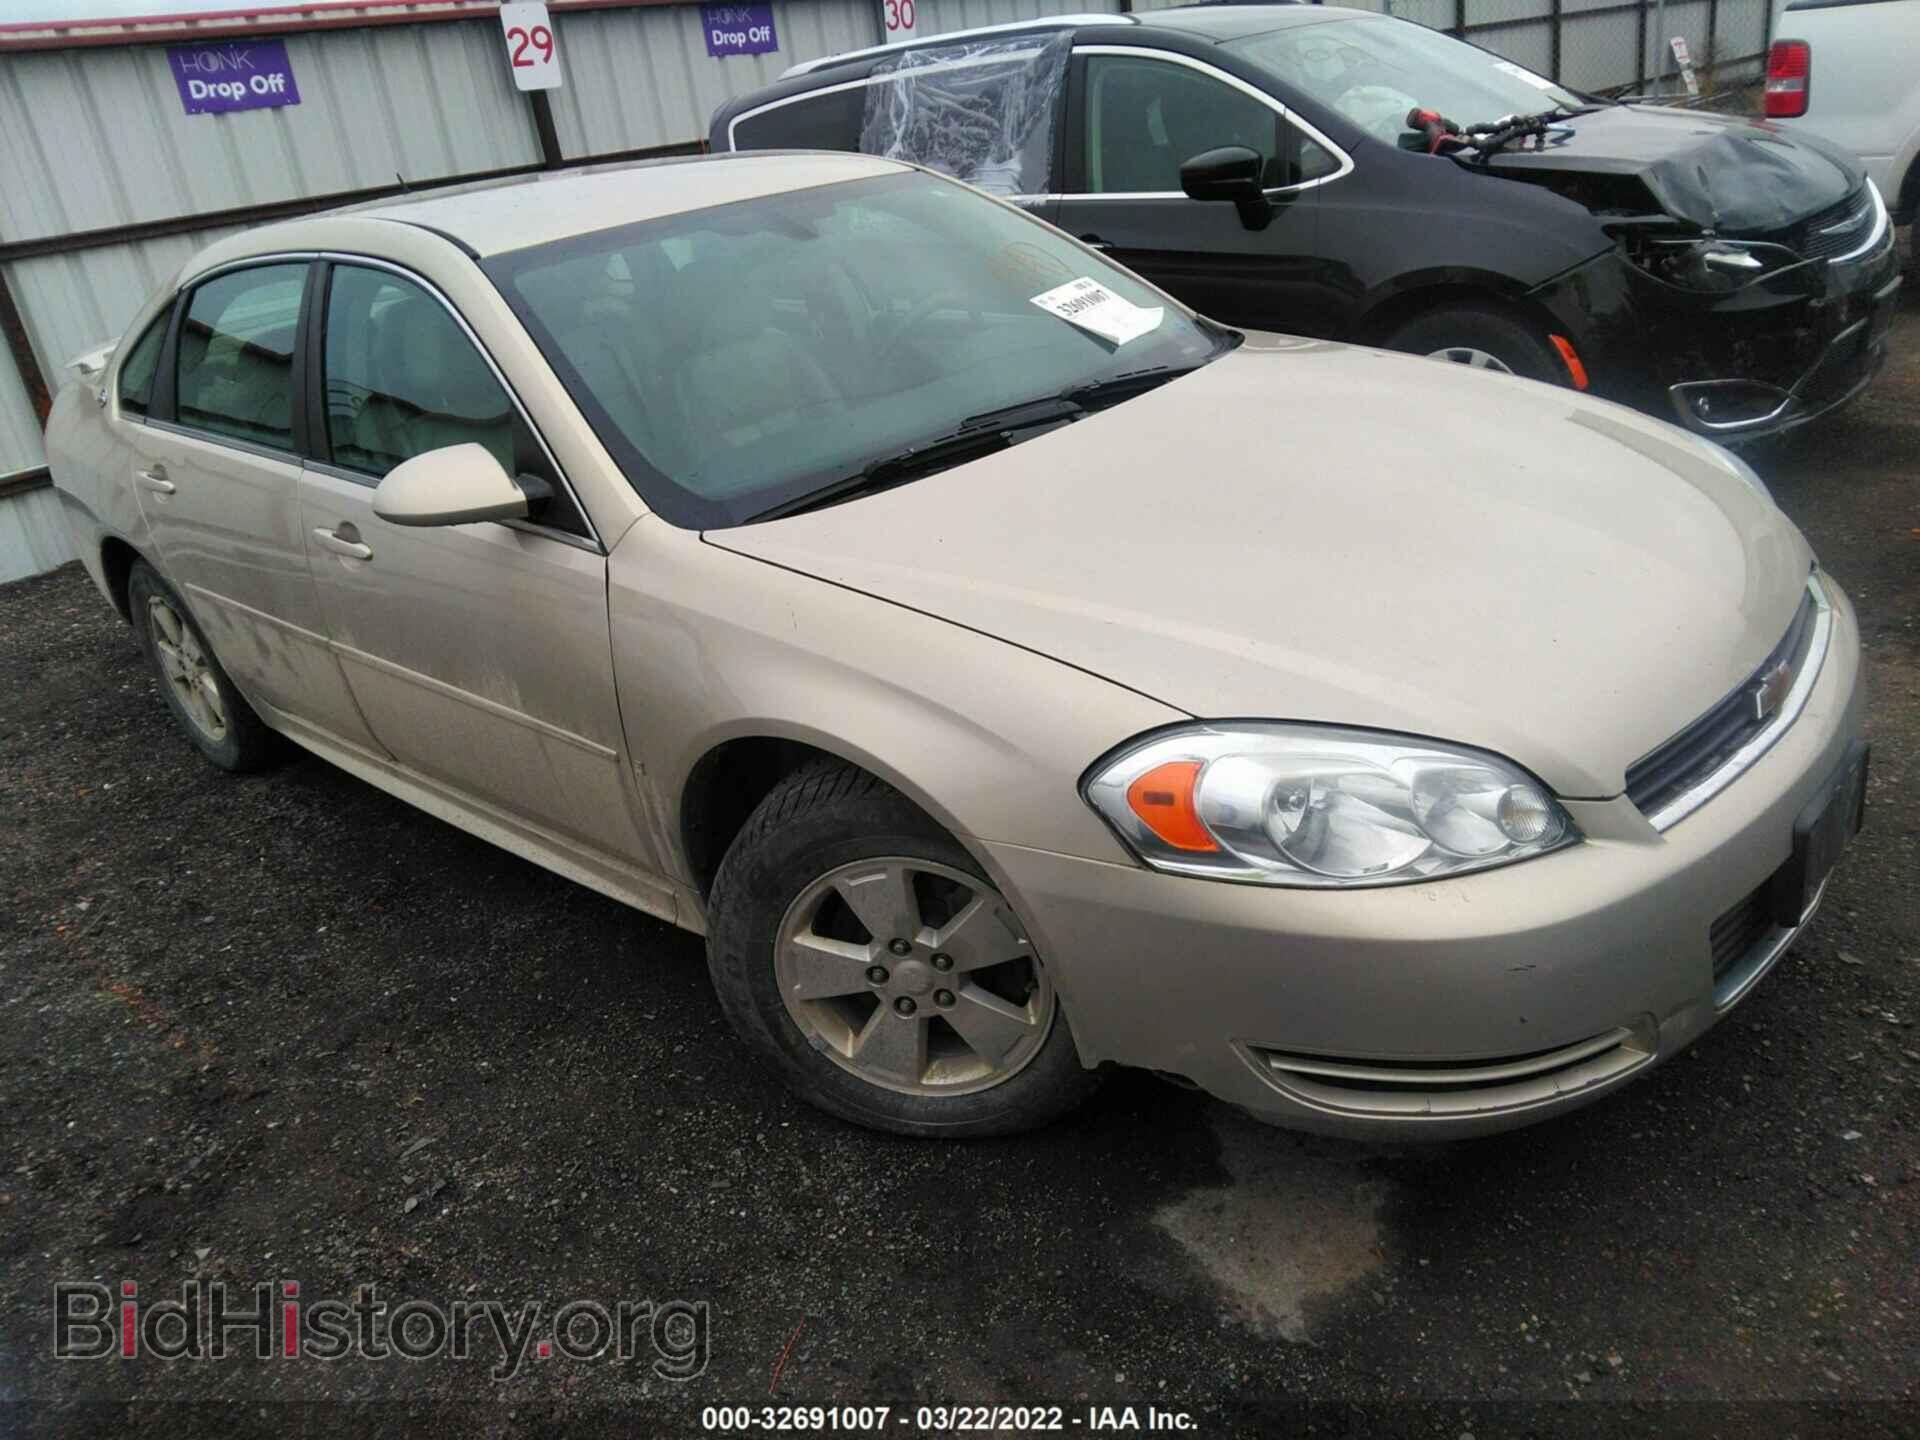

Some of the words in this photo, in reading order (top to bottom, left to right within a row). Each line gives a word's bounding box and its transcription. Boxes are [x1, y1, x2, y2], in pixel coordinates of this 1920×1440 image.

[707, 7, 752, 24] HONK
[886, 0, 914, 30] 30
[507, 25, 553, 67] 29
[712, 30, 746, 48] Drop
[748, 26, 770, 42] Off
[179, 49, 255, 73] HONK
[188, 80, 246, 101] Drop
[250, 73, 285, 94] Off
